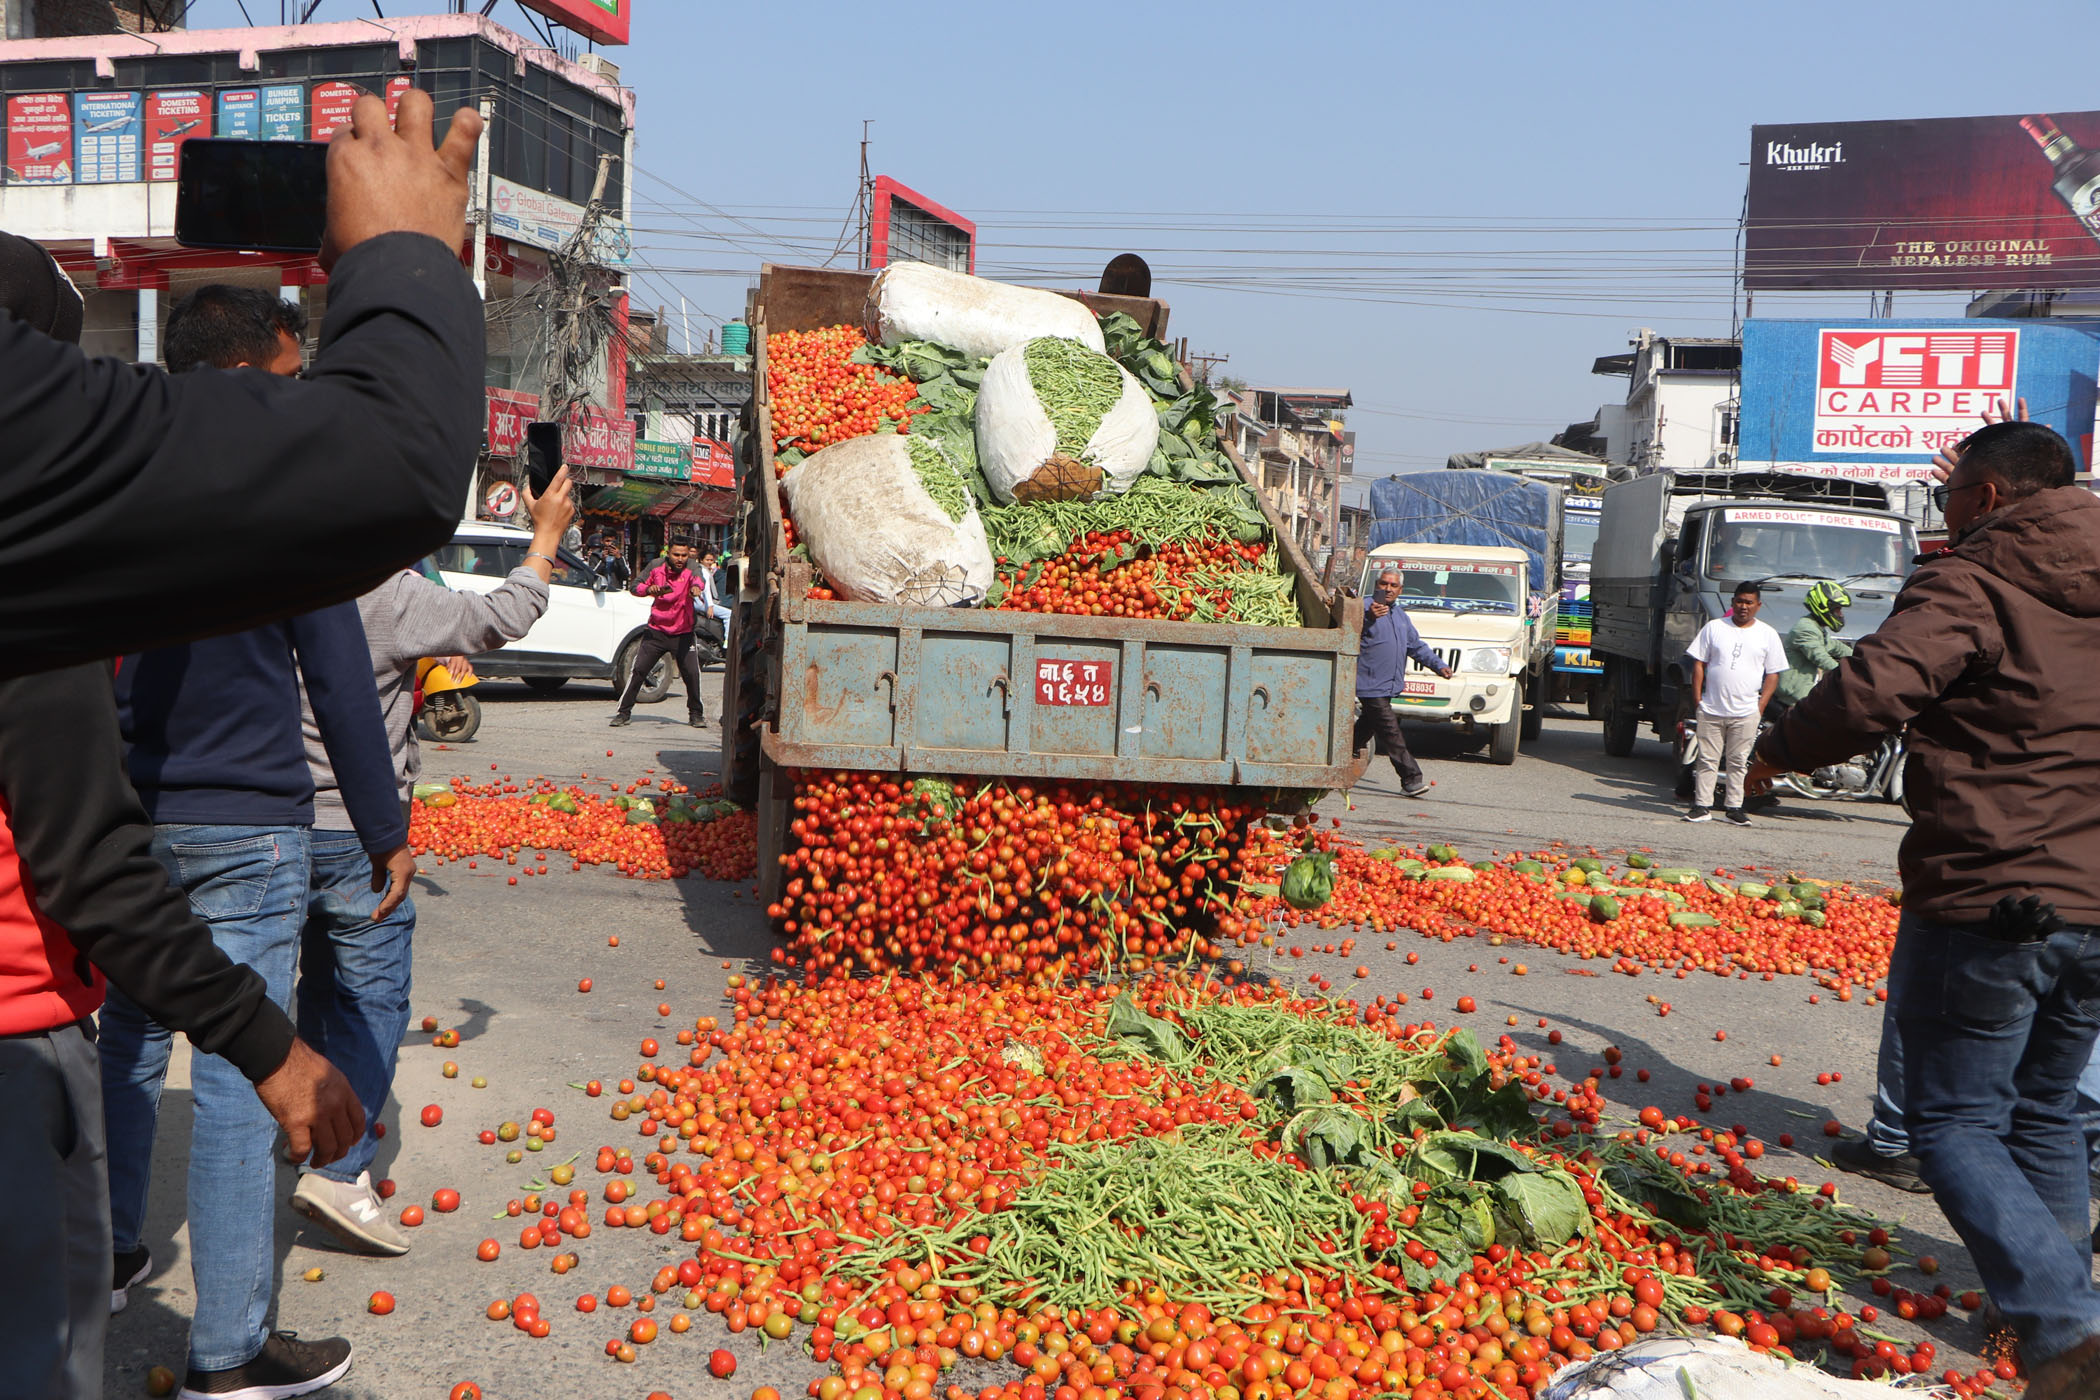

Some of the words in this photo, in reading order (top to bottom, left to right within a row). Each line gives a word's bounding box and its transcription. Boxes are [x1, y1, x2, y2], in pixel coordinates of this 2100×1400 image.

[267, 89, 298, 97] BUNGEE
[81, 102, 136, 110] INTERNATIONAL
[266, 97, 299, 105] JUMPING
[90, 110, 126, 118] TICKETING
[157, 106, 200, 115] TICKETING
[265, 112, 300, 122] TICKETS
[516, 191, 545, 213] Global
[1896, 241, 1936, 254] THE
[1945, 239, 2049, 252] ORIGINAL
[1890, 255, 1996, 267] NEPALESE
[2005, 253, 2052, 265] RUM
[1831, 336, 2006, 386] YETI
[1828, 391, 2001, 414] CARPET
[1735, 511, 1772, 520] ARMED
[1819, 514, 1854, 526] FORCE
[1860, 519, 1893, 530] NEPAL
[1083, 664, 1099, 682] त
[1042, 683, 1105, 705] १६५४
